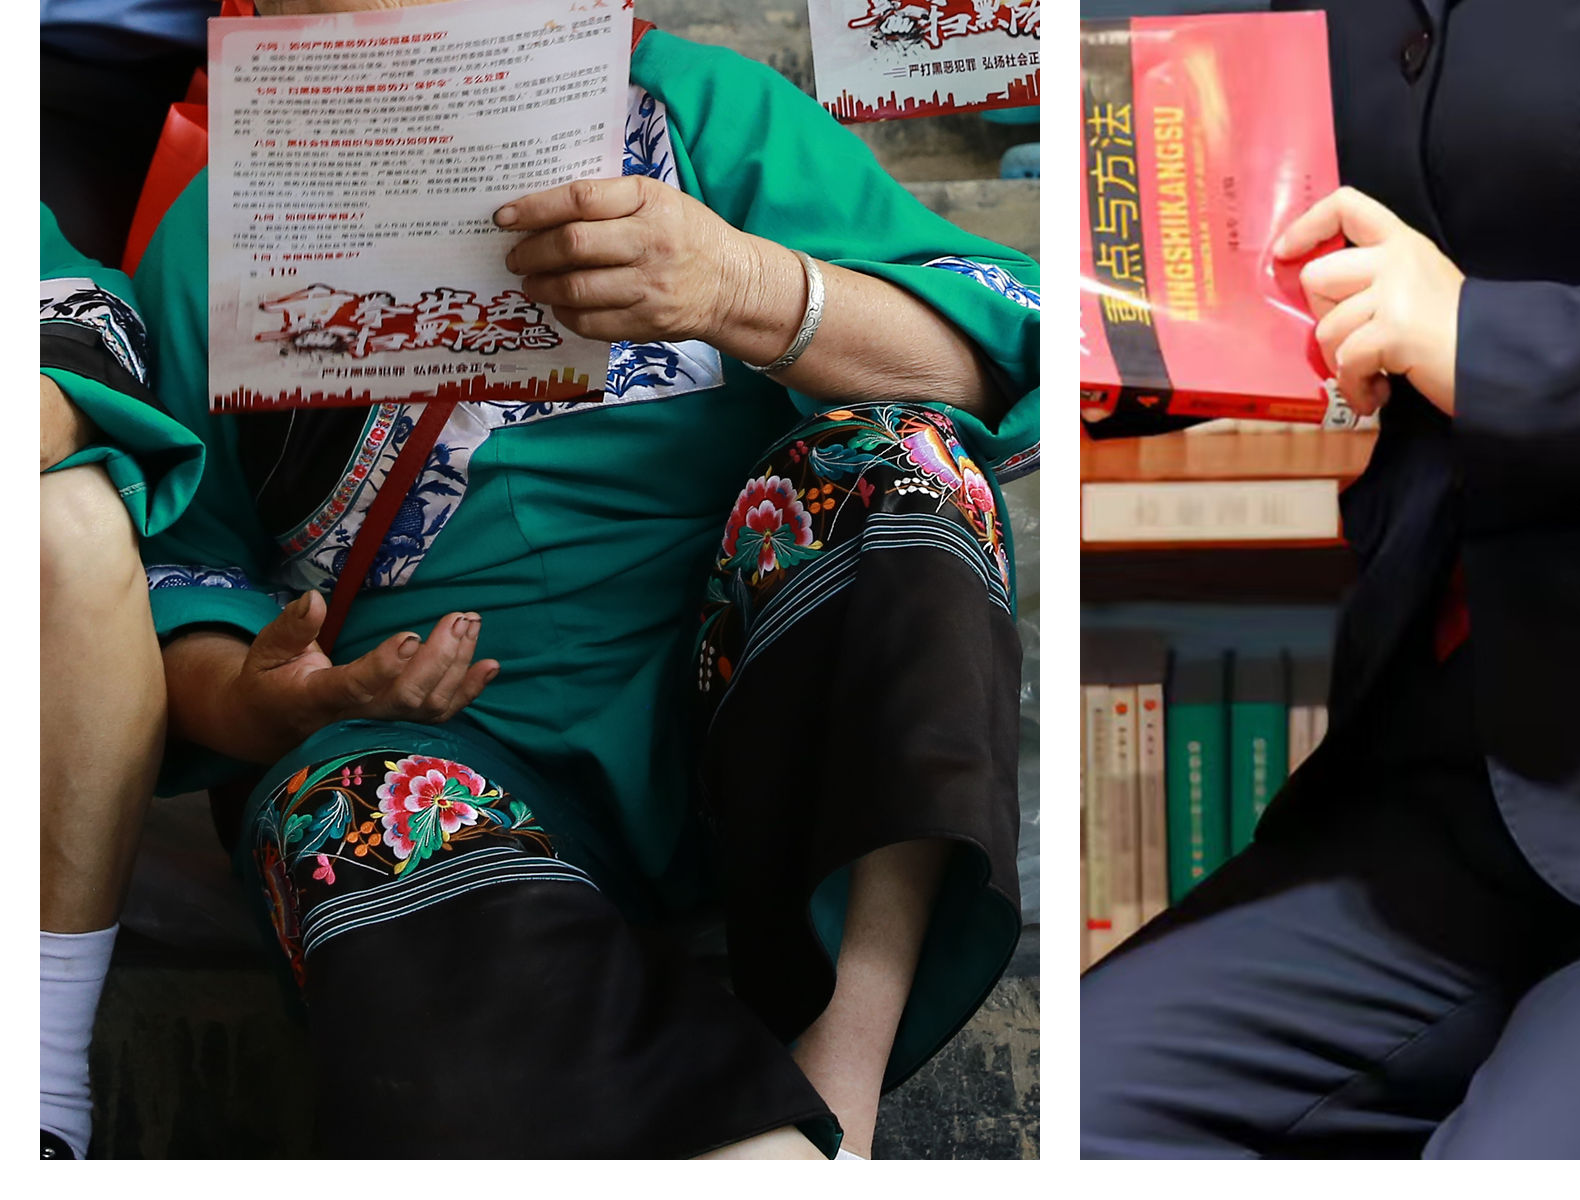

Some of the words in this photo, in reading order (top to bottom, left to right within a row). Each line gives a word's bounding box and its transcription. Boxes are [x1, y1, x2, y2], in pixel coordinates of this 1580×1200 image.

[908, 57, 976, 78] 严打黑恶犯罪
[1086, 102, 1151, 325] 重点与方法
[268, 267, 297, 277] 110
[413, 362, 497, 376] 弘扬社会正气
